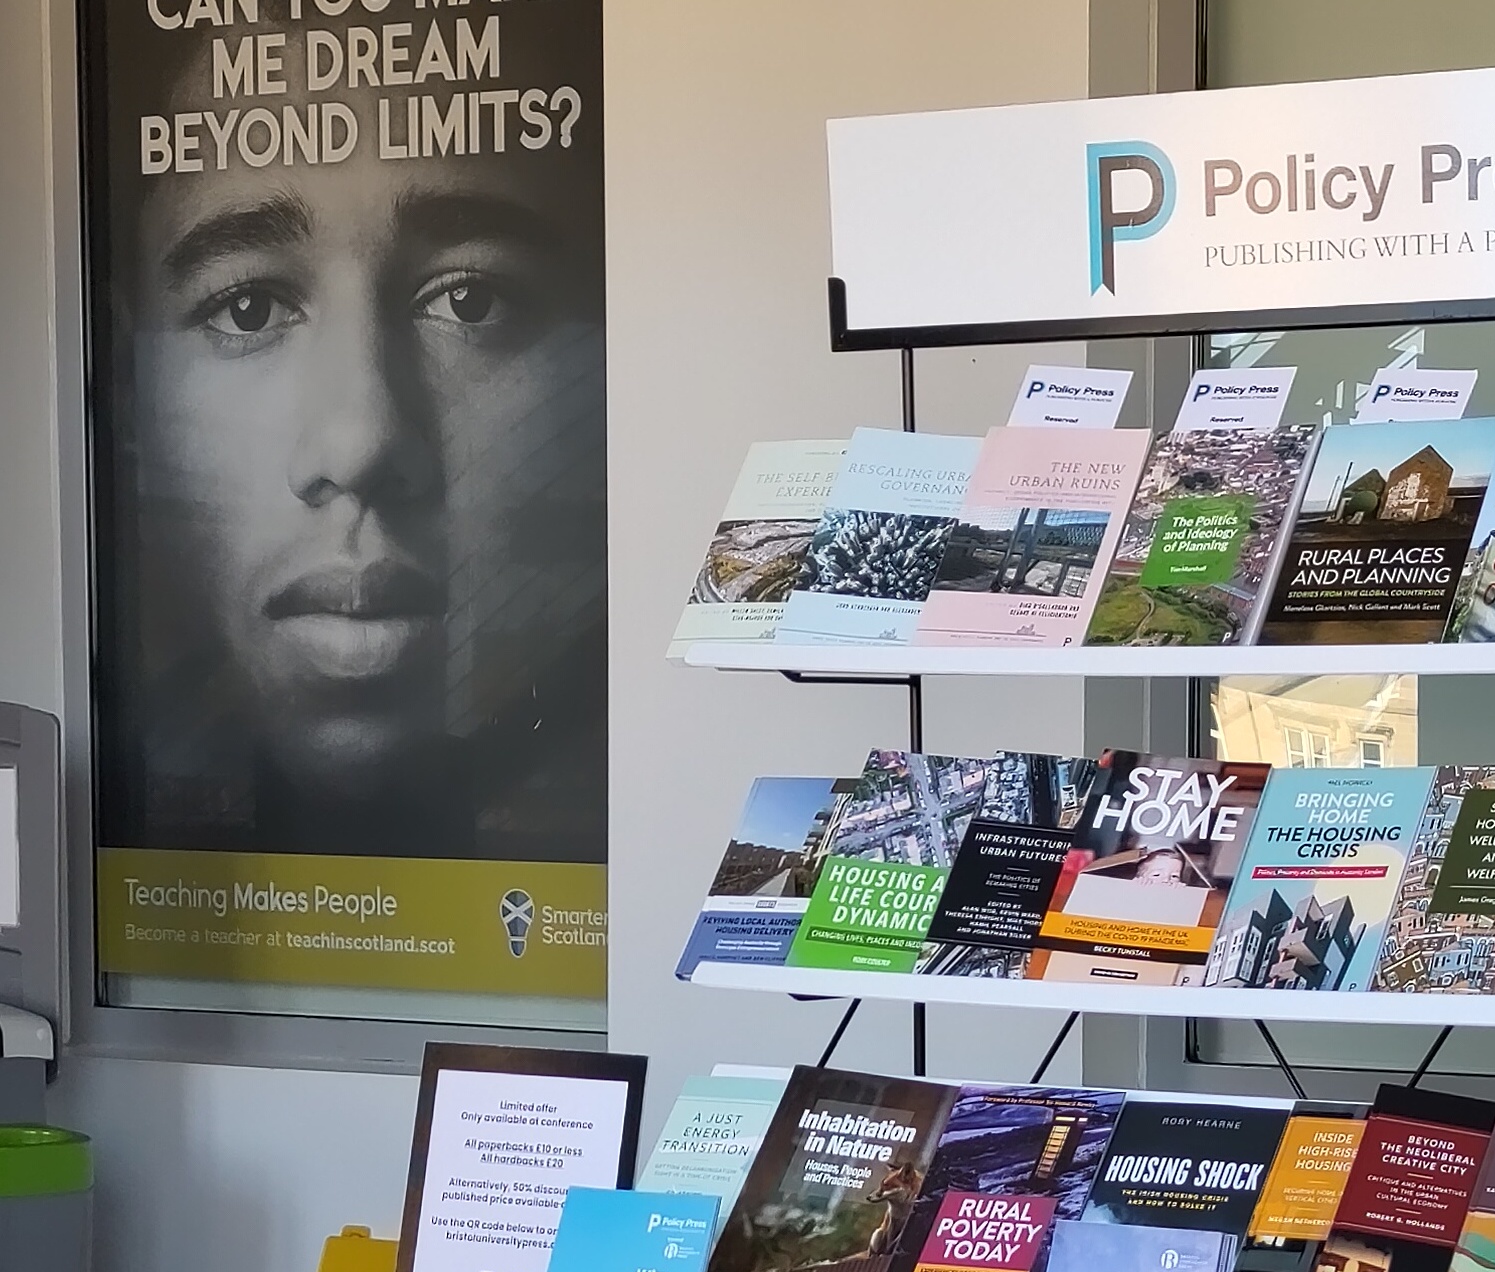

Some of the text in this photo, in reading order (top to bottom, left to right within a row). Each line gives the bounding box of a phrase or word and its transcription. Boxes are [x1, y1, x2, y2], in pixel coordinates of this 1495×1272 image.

[212, 33, 287, 98] ME
[306, 15, 500, 91] DREAM
[140, 86, 582, 174] BEYOND LIMITS?
[1203, 152, 1394, 222] Policy
[1204, 235, 1367, 268] PUBLISHING
[1374, 230, 1450, 258] WITH
[1458, 229, 1475, 253] A
[1213, 382, 1280, 397] Policy Press
[848, 463, 972, 484] RESCALING URBA
[1050, 462, 1126, 475] THE NEW
[1009, 476, 1121, 491] URBAN RUINS
[1172, 514, 1238, 528] The Politics
[1163, 527, 1239, 542] and Ideology
[1163, 539, 1229, 553] of Planning
[1298, 546, 1445, 567] RURAL PLACES
[1291, 566, 1451, 586] AND PLANNING
[1124, 767, 1238, 808] STAY
[1294, 792, 1394, 809] BRINGING
[1092, 794, 1245, 841] HOME
[1308, 808, 1370, 824] HOME
[1267, 826, 1401, 843] THE HOUSING
[980, 846, 1068, 864] URBAN FUTURES
[1297, 843, 1359, 858] CRISIS
[124, 878, 397, 922] Teaching Makes People
[832, 906, 933, 932] DYNAMIC
[125, 924, 455, 955] Become a teacher at teachinscotland.scot
[683, 1126, 741, 1139] ENERGY
[798, 1109, 917, 1144] Inhabitation
[1162, 1117, 1242, 1131] RORY HEARNE
[804, 1131, 893, 1162] in Nature
[1314, 1131, 1354, 1145] INSIDE
[1408, 1135, 1455, 1150] BEYOND
[662, 1140, 750, 1157] TRANSITION
[1298, 1145, 1359, 1159] HIGH-RISE
[1380, 1141, 1475, 1167] THE NEOLIBERAL
[804, 1158, 872, 1181] Houses, People
[1104, 1154, 1264, 1191] HOUSING SHOCK
[1295, 1159, 1352, 1172] HOUSING
[1382, 1153, 1467, 1176] CREATIVE CITY
[803, 1171, 864, 1190] and Practices
[442, 1190, 559, 1209] published price available
[958, 1198, 1032, 1222] RURAL
[937, 1218, 1043, 1243] POVERTY
[943, 1239, 1020, 1263] TODAY
